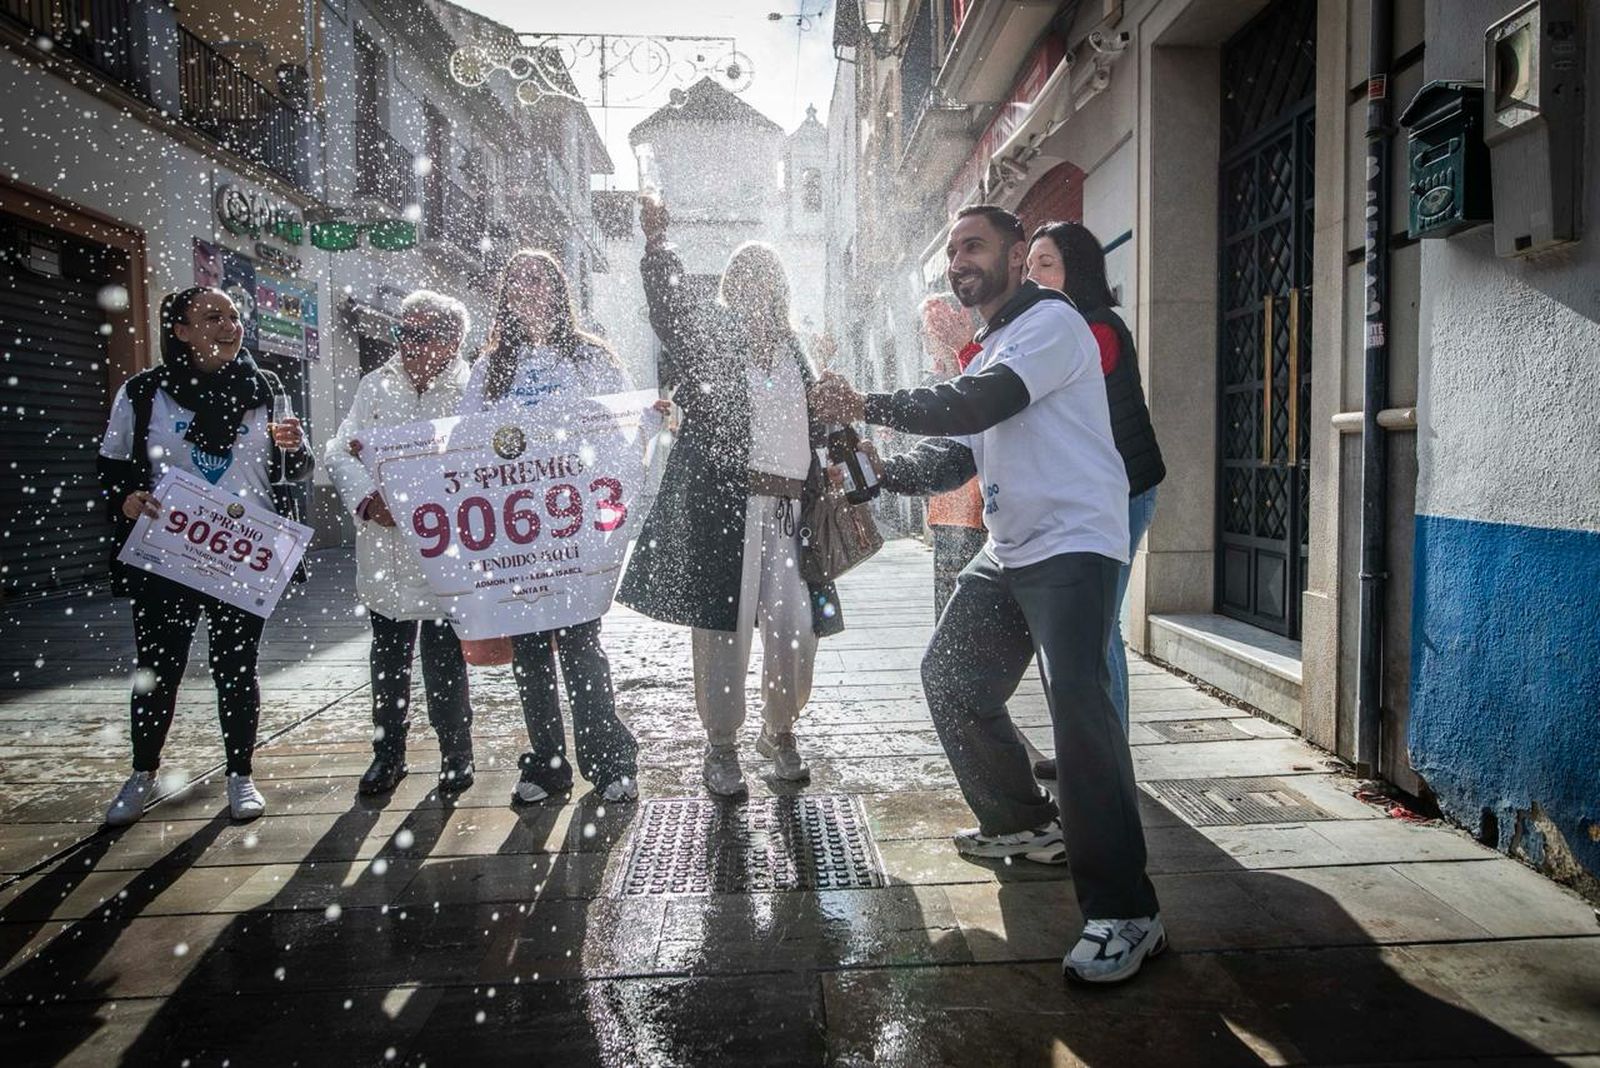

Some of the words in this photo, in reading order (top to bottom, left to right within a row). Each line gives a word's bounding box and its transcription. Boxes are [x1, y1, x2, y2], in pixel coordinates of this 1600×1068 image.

[474, 453, 584, 490] PREMIO
[165, 511, 273, 572] 90693
[209, 511, 264, 542] PREMIO
[412, 476, 628, 559] 90693
